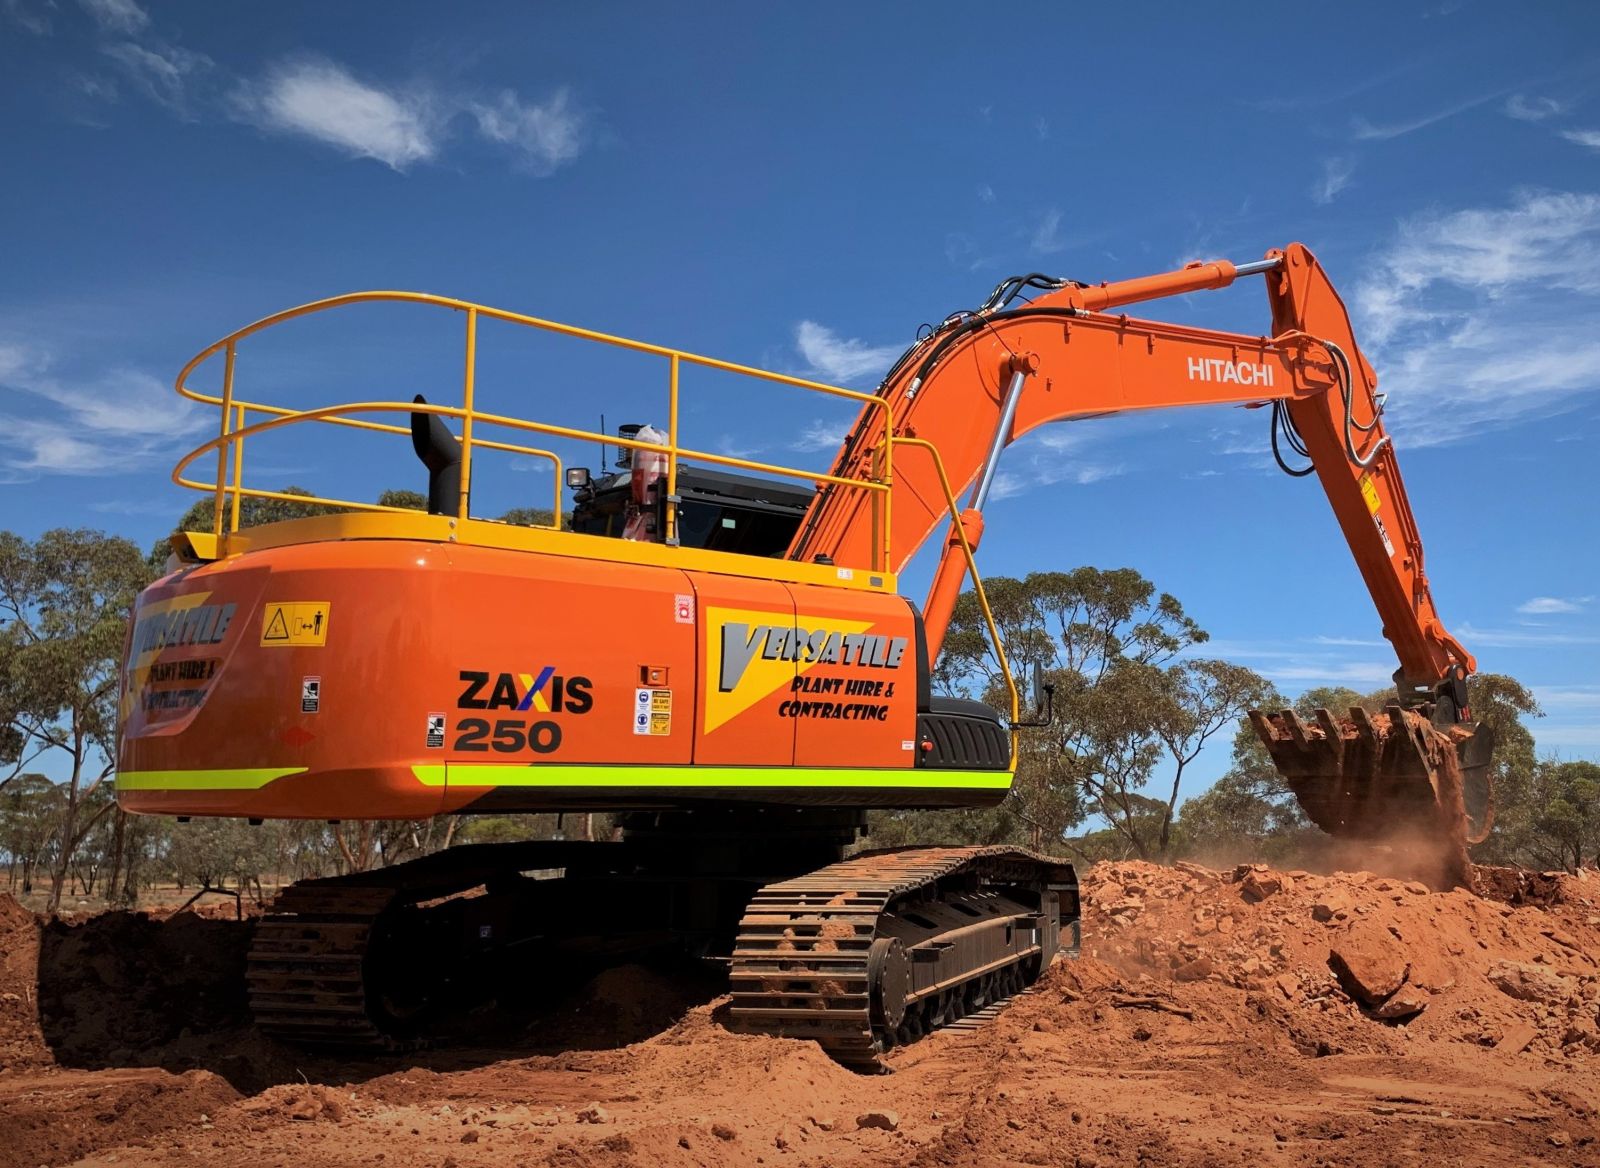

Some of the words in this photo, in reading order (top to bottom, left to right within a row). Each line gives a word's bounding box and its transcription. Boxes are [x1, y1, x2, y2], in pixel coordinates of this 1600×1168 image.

[1187, 357, 1274, 387] HITACHI
[719, 622, 908, 692] VERSATILE
[457, 666, 594, 714] ZAXIS
[790, 676, 843, 693] PLANT
[848, 680, 885, 697] HIRE
[885, 683, 895, 698] &
[778, 700, 888, 721] CONTRACTING
[453, 718, 562, 753] 250
